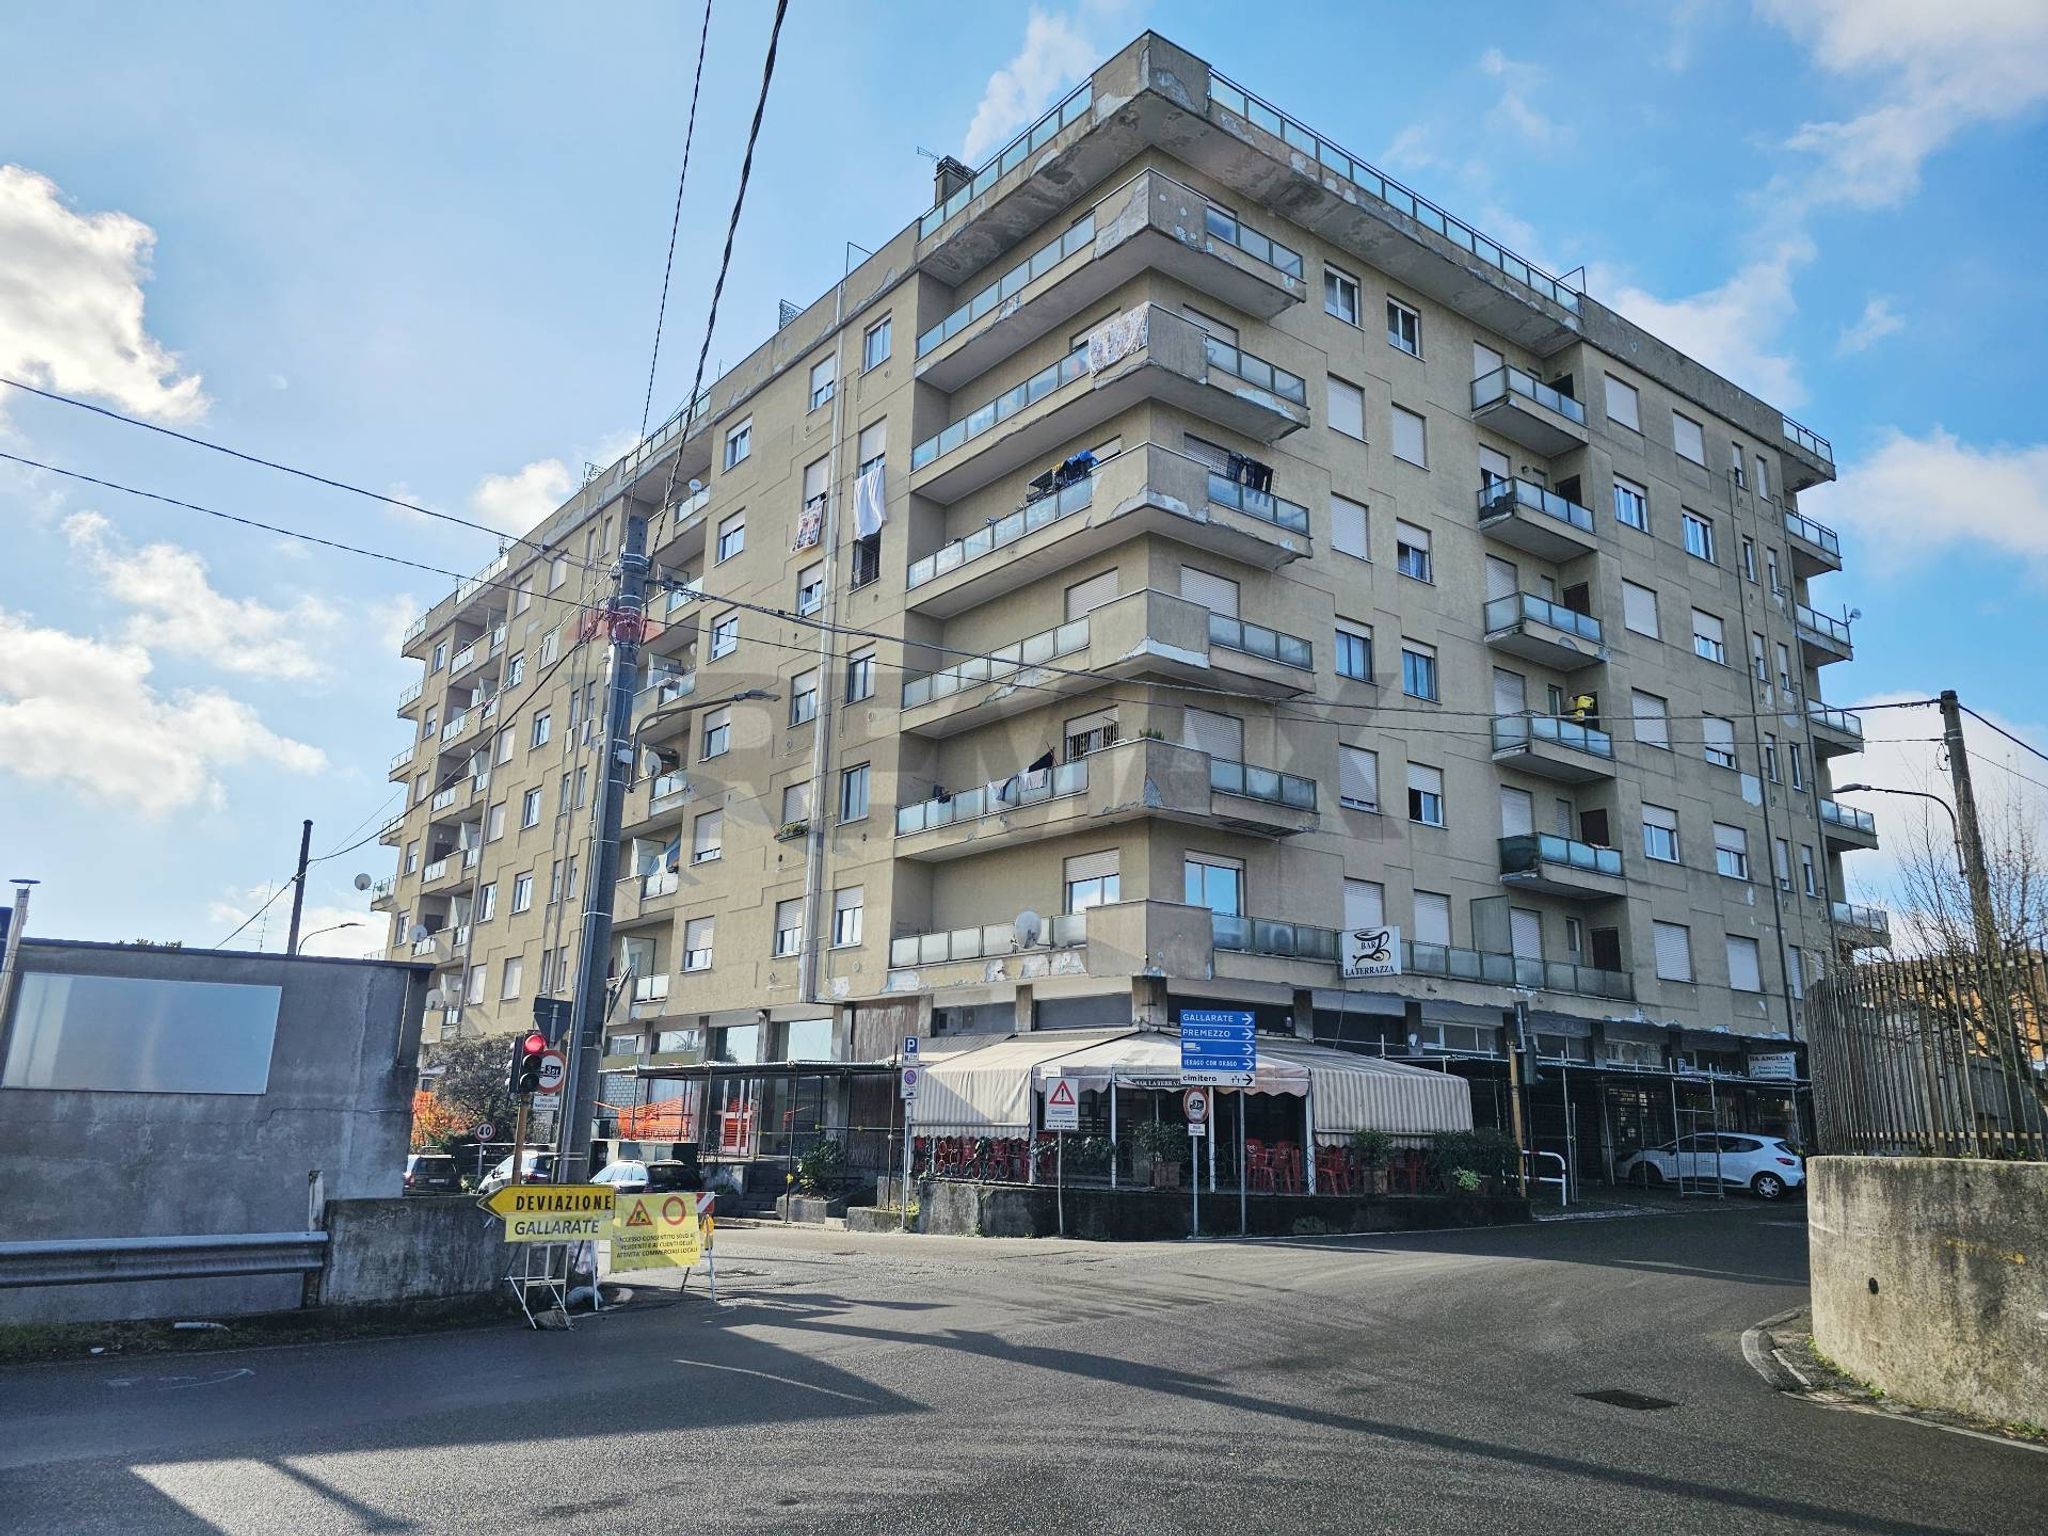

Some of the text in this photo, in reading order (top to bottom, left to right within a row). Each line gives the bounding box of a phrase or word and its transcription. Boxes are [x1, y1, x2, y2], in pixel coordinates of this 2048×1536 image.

[1361, 940, 1376, 950] BAR
[1345, 965, 1395, 976] LA TERRAZZA
[1182, 1013, 1234, 1022] GALLARATE
[1182, 1028, 1231, 1037] PREMEZZO
[907, 1039, 916, 1052] P
[1182, 1073, 1218, 1082] cimitero
[479, 1126, 491, 1136] 40
[515, 1195, 612, 1211] DEVIAZIONE
[514, 1220, 600, 1235] GALLARATE
